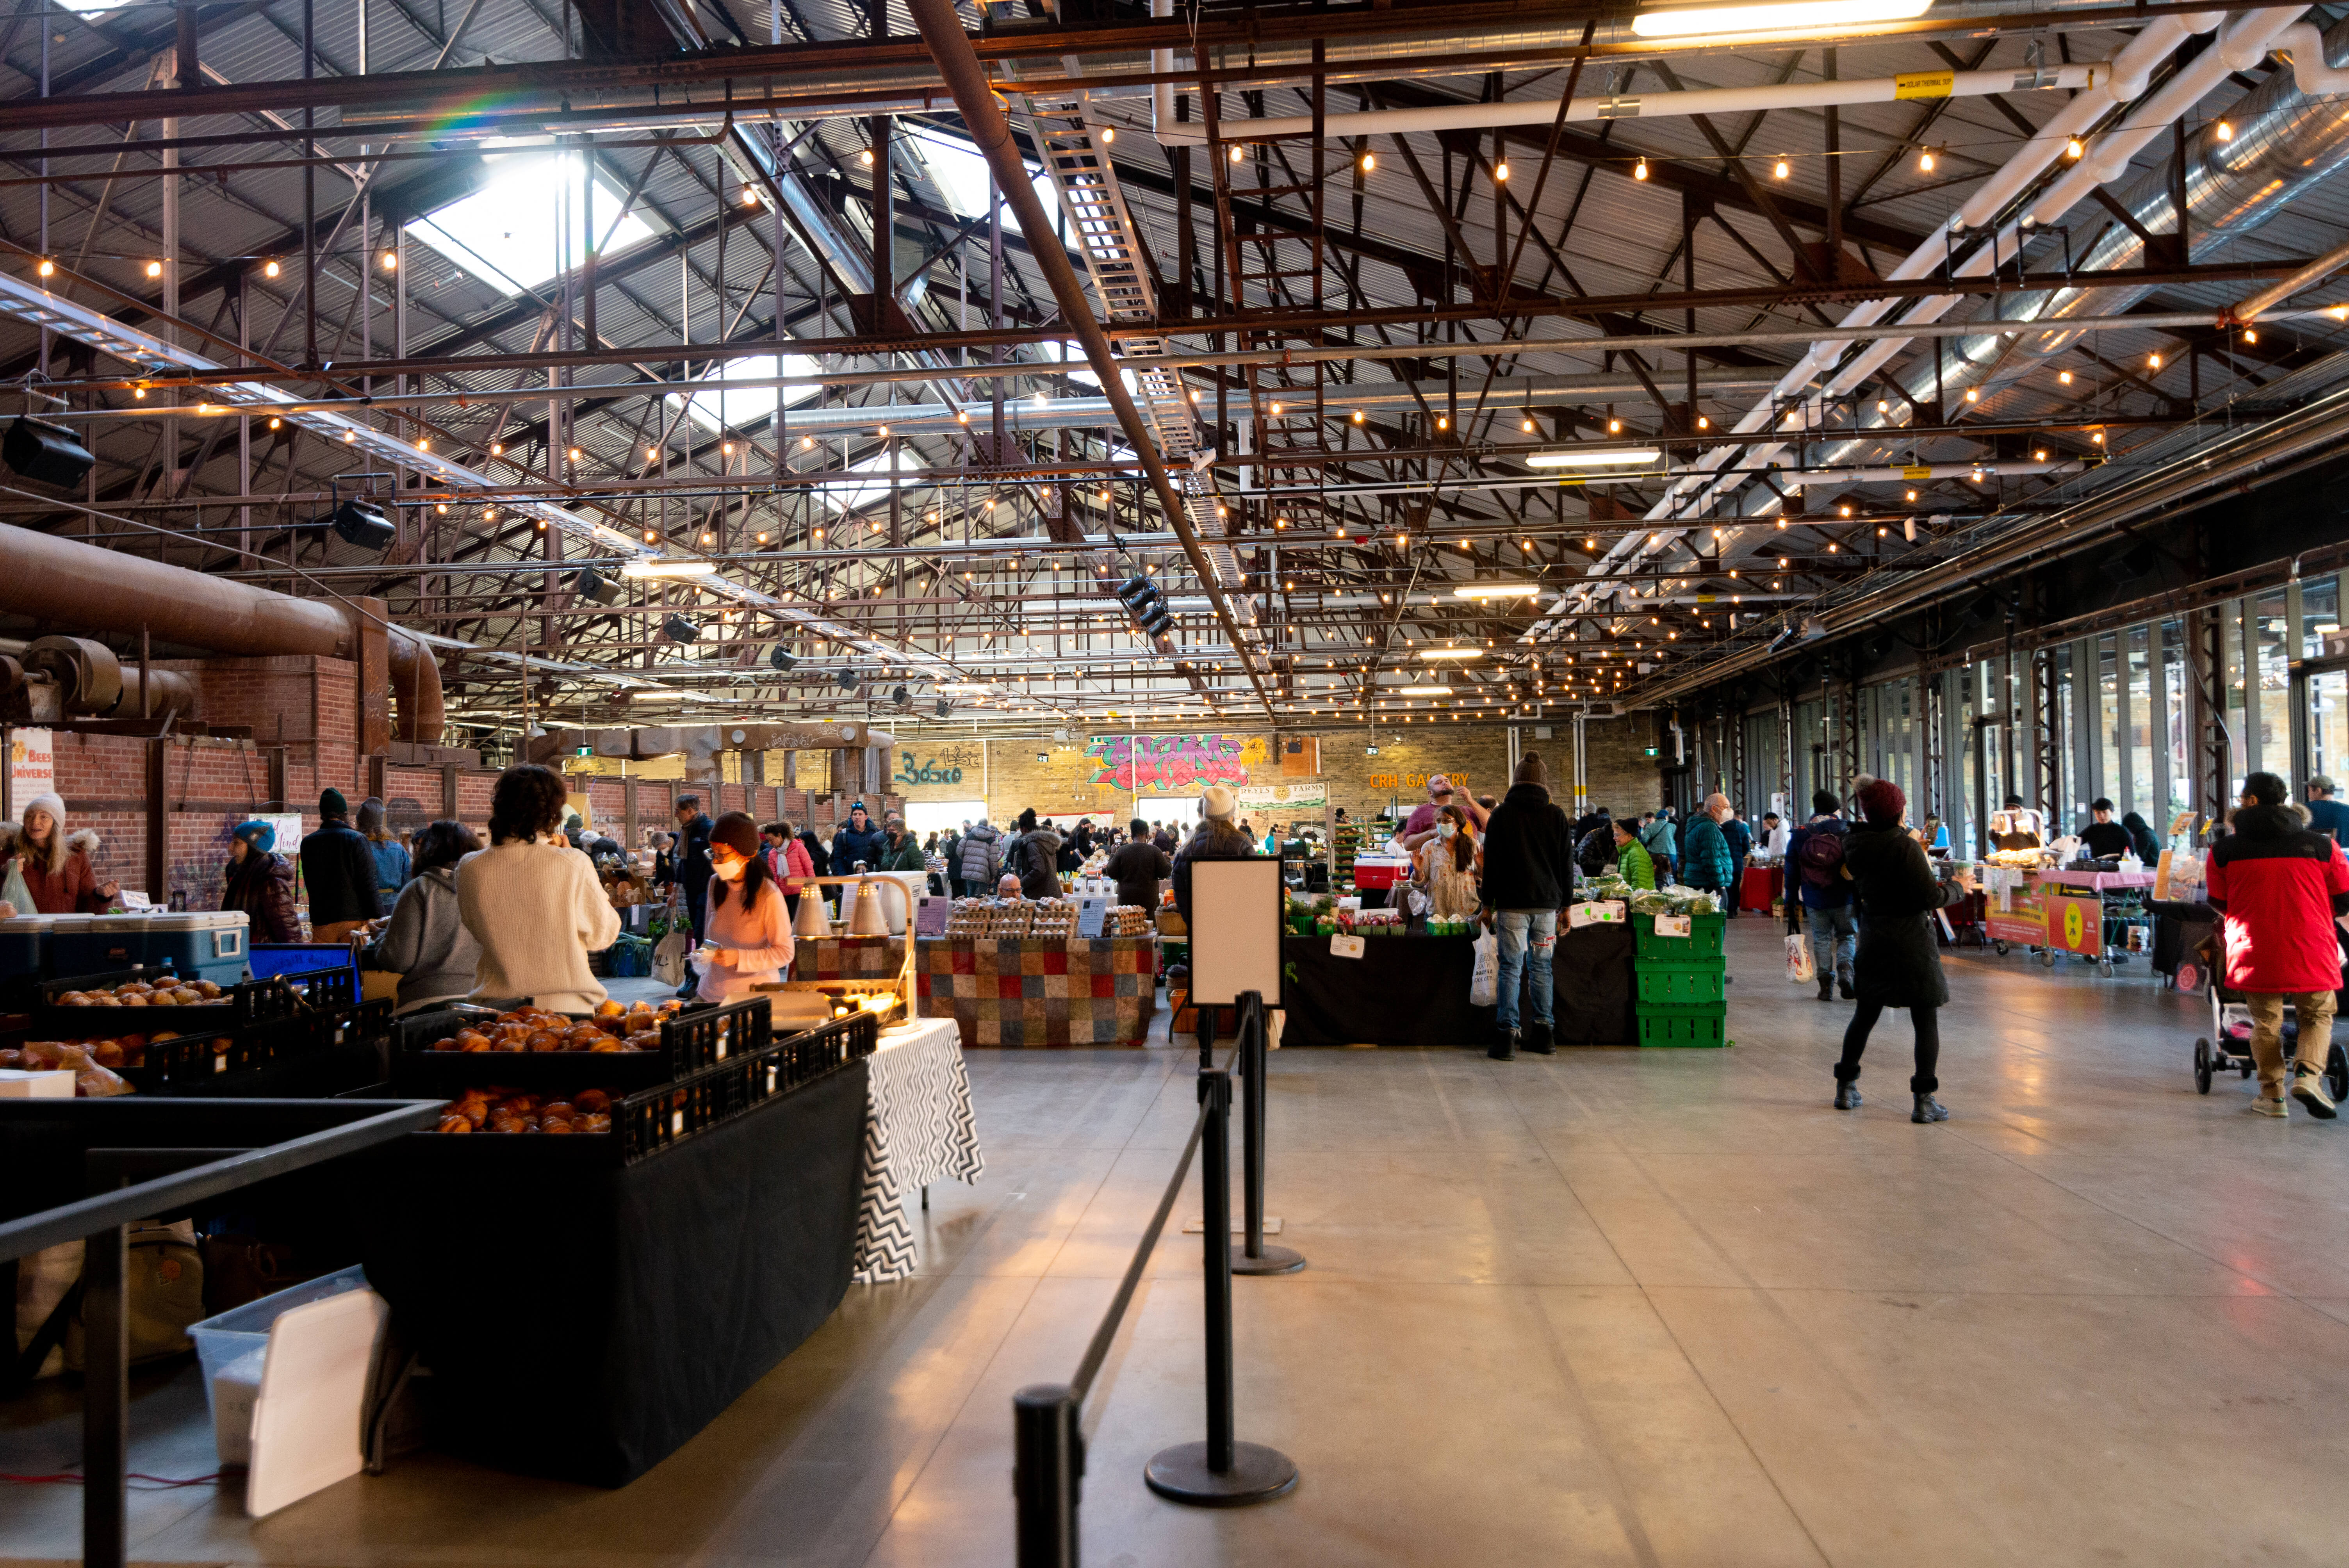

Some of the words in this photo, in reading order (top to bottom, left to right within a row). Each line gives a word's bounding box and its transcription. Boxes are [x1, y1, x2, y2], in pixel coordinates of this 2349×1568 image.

[1370, 774, 1398, 788] CRH
[1406, 773, 1469, 787] GARY
[285, 825, 294, 833] OUT
